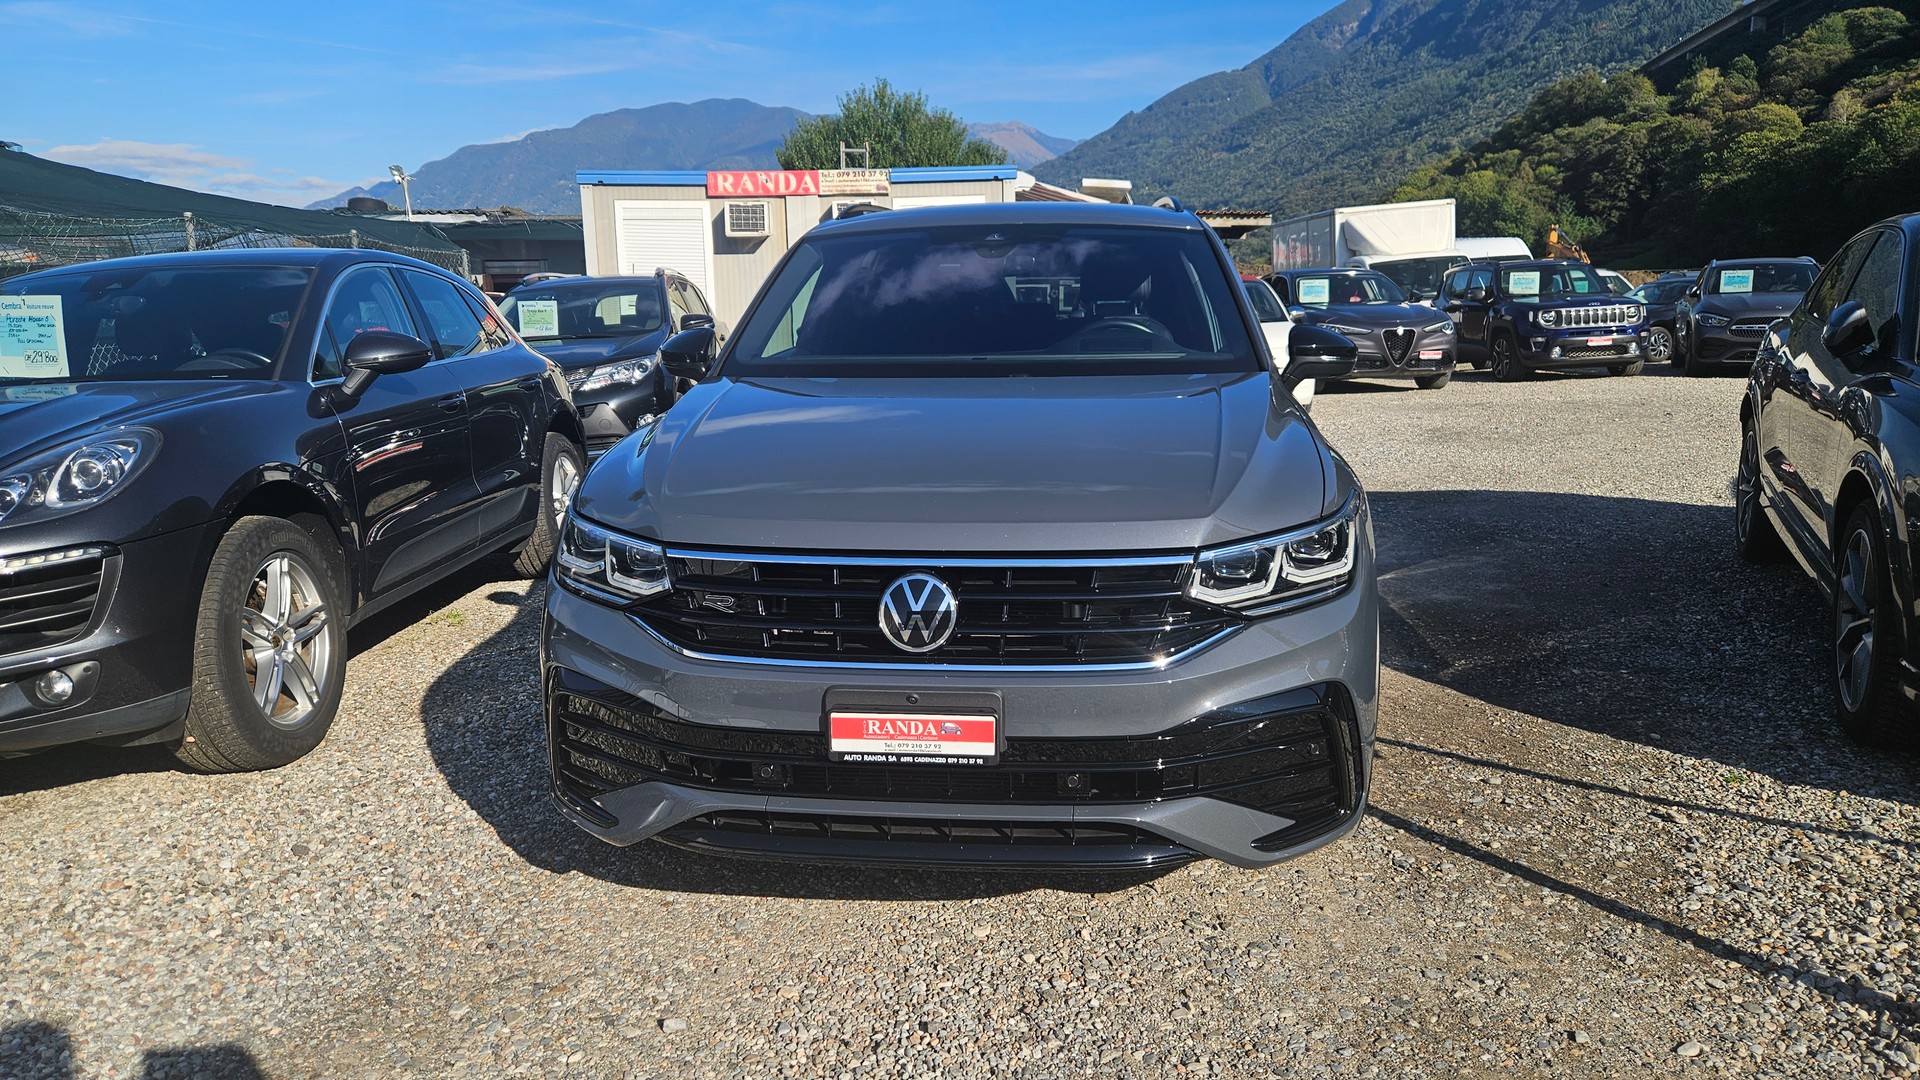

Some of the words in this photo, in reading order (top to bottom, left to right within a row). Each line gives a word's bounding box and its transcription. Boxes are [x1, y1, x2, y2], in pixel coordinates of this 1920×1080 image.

[716, 172, 819, 194] RANDA
[867, 719, 938, 736] RANDA
[863, 754, 887, 762] RANDA
[888, 754, 897, 762] SA
[914, 756, 946, 764] CADENAZZO
